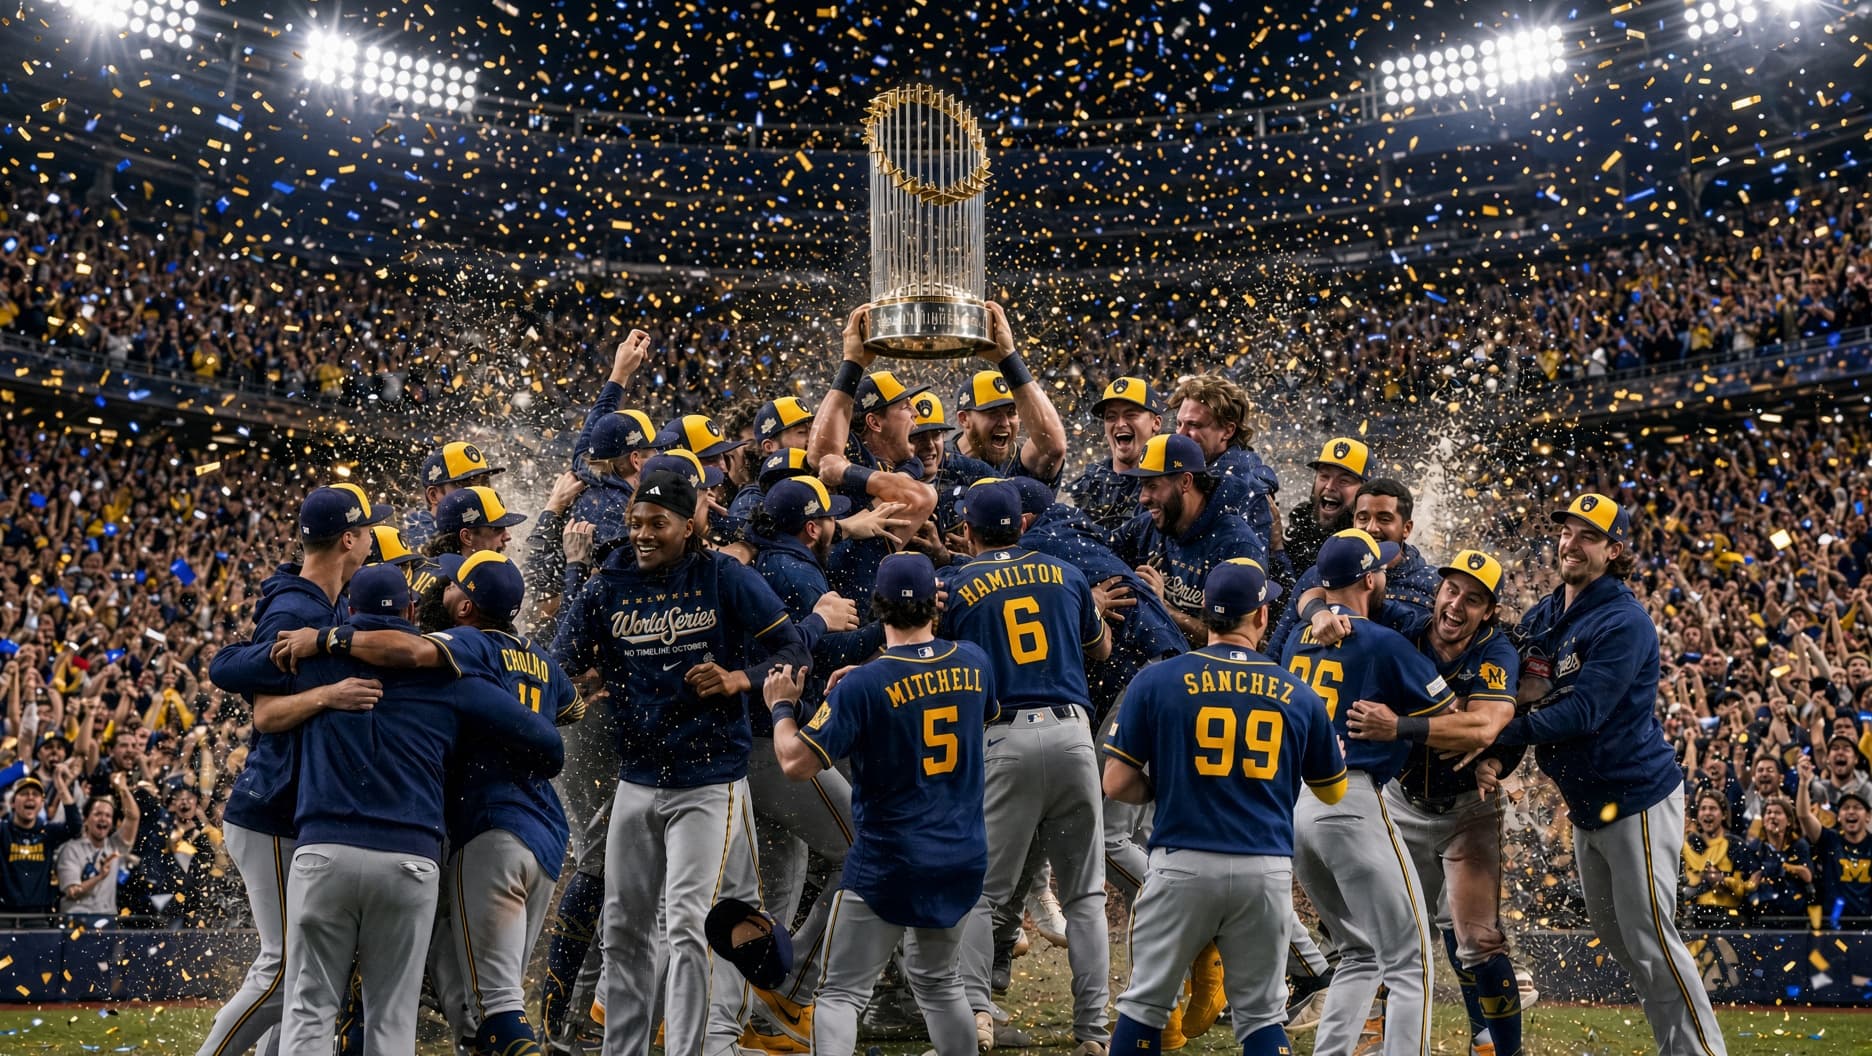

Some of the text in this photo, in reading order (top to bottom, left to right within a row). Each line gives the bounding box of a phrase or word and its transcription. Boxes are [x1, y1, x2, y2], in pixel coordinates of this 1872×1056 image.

[958, 563, 1064, 607] HAMILTON
[672, 641, 708, 654] OCTOBER
[1002, 595, 1049, 665] 6
[885, 667, 983, 709] MITCHELL
[1183, 663, 1295, 705] SÁNCHEZ
[923, 705, 958, 777] 5
[1194, 706, 1284, 781] 99
[1839, 858, 1872, 882] M
